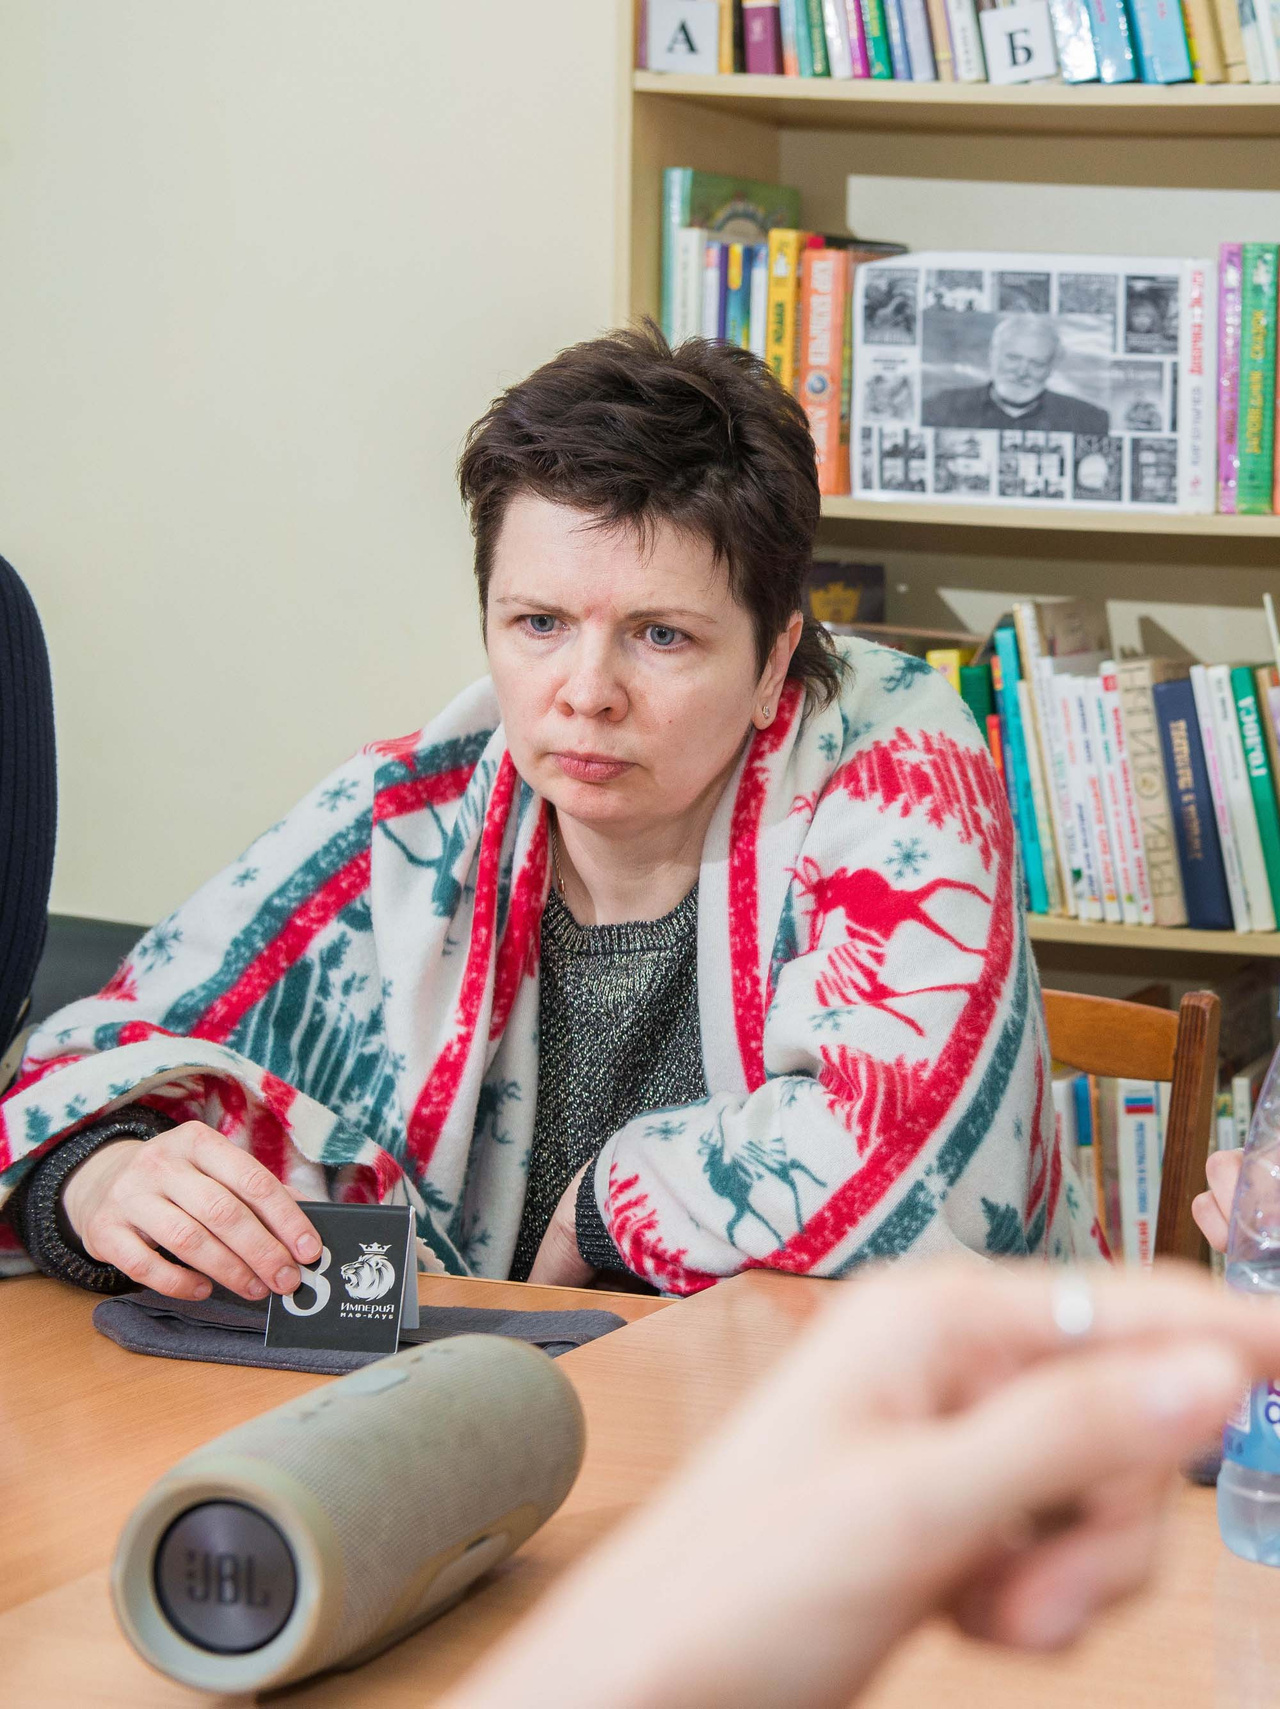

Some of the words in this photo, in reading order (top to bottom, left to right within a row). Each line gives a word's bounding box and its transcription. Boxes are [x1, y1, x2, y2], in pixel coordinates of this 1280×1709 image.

[667, 20, 700, 54] А
[1006, 29, 1034, 67] Б
[1238, 695, 1265, 777] ГОЛОСА
[282, 1245, 332, 1317] 8
[187, 1550, 270, 1608] JBL
